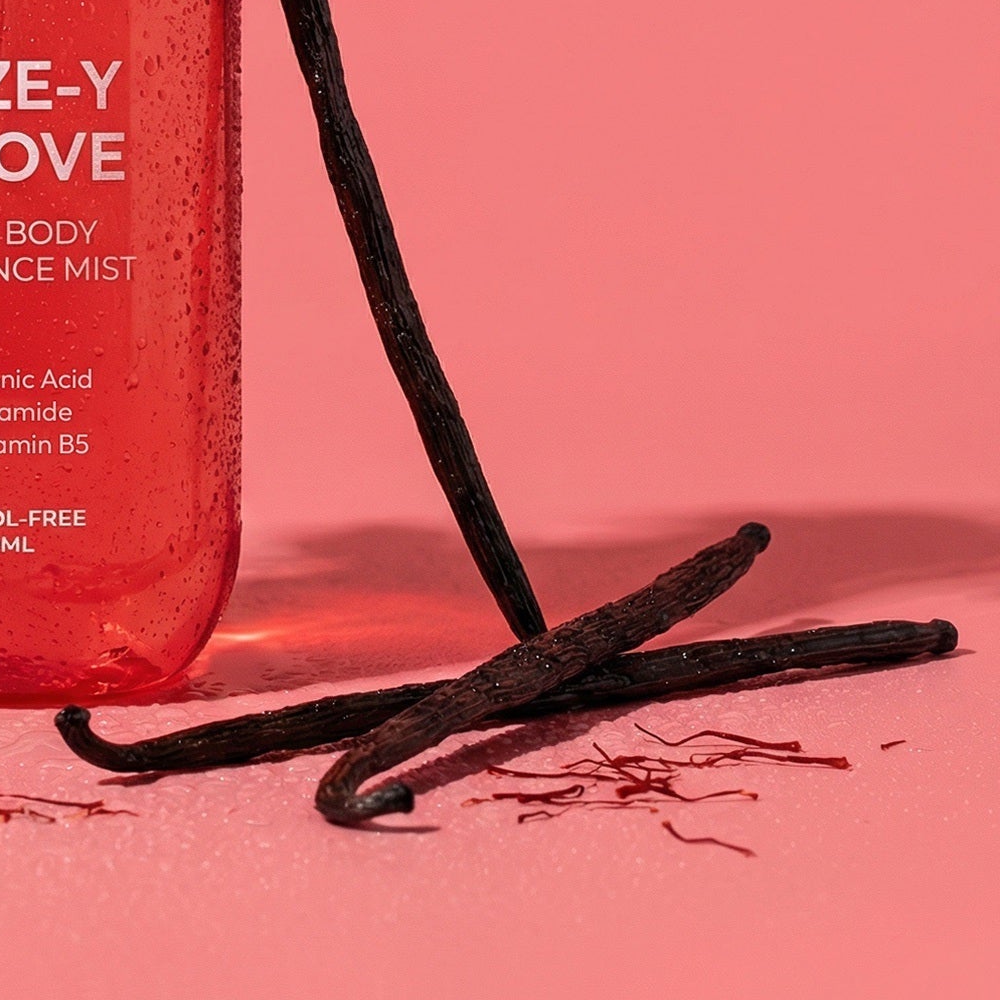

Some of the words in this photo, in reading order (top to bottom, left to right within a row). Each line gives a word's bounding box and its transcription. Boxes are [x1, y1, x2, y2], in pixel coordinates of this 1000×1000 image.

[5, 219, 99, 246] BODY
[64, 255, 137, 281] MIST
[40, 368, 93, 390] Acid
[58, 433, 90, 455] B5
